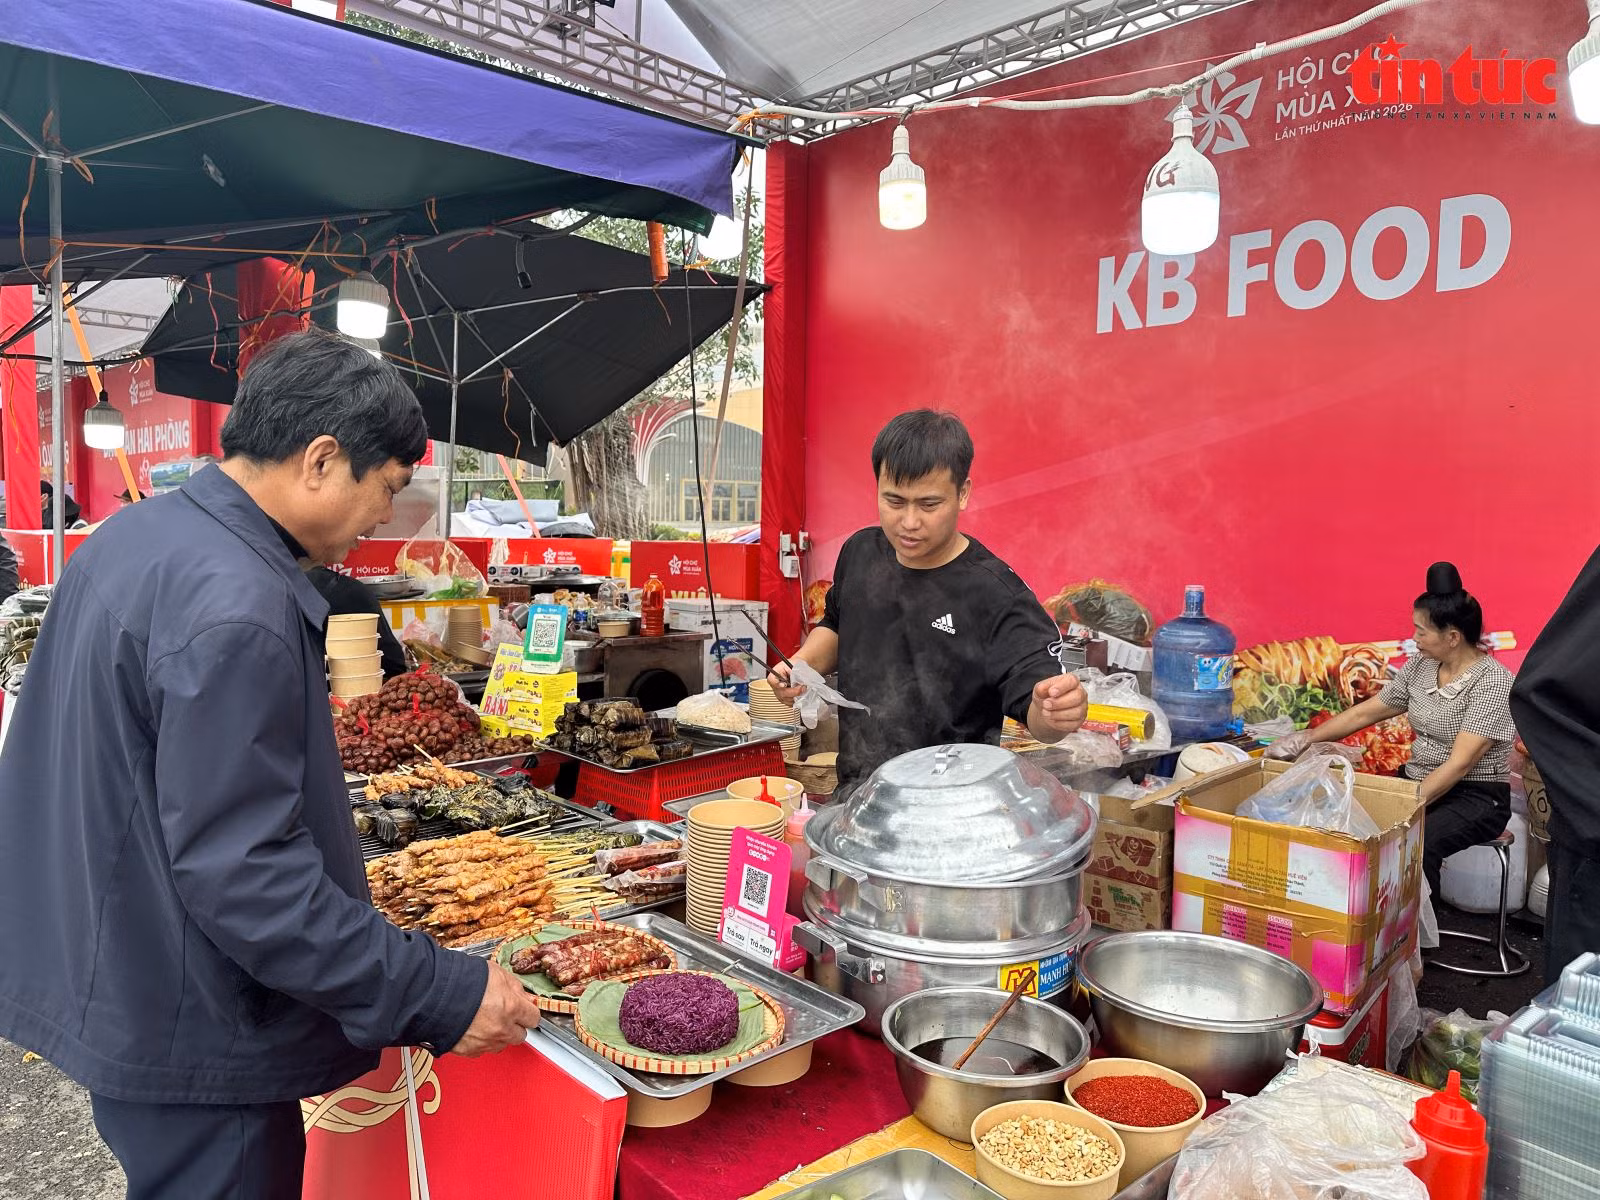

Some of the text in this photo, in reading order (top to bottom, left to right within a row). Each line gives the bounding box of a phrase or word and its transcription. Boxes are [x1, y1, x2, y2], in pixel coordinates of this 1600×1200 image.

[1277, 56, 1324, 91] HỘI
[1275, 126, 1297, 141] LẦN
[1299, 120, 1321, 135] THỨ
[1322, 112, 1352, 130] NHẤT
[1383, 103, 1413, 117] 2026
[1276, 90, 1336, 124] MÙA
[1096, 193, 1512, 334] KB FOOD
[138, 419, 153, 454] HẢI
[155, 417, 190, 452] PHÒNG
[931, 621, 956, 635] adidas
[735, 932, 745, 942] sau
[759, 944, 774, 956] ngay
